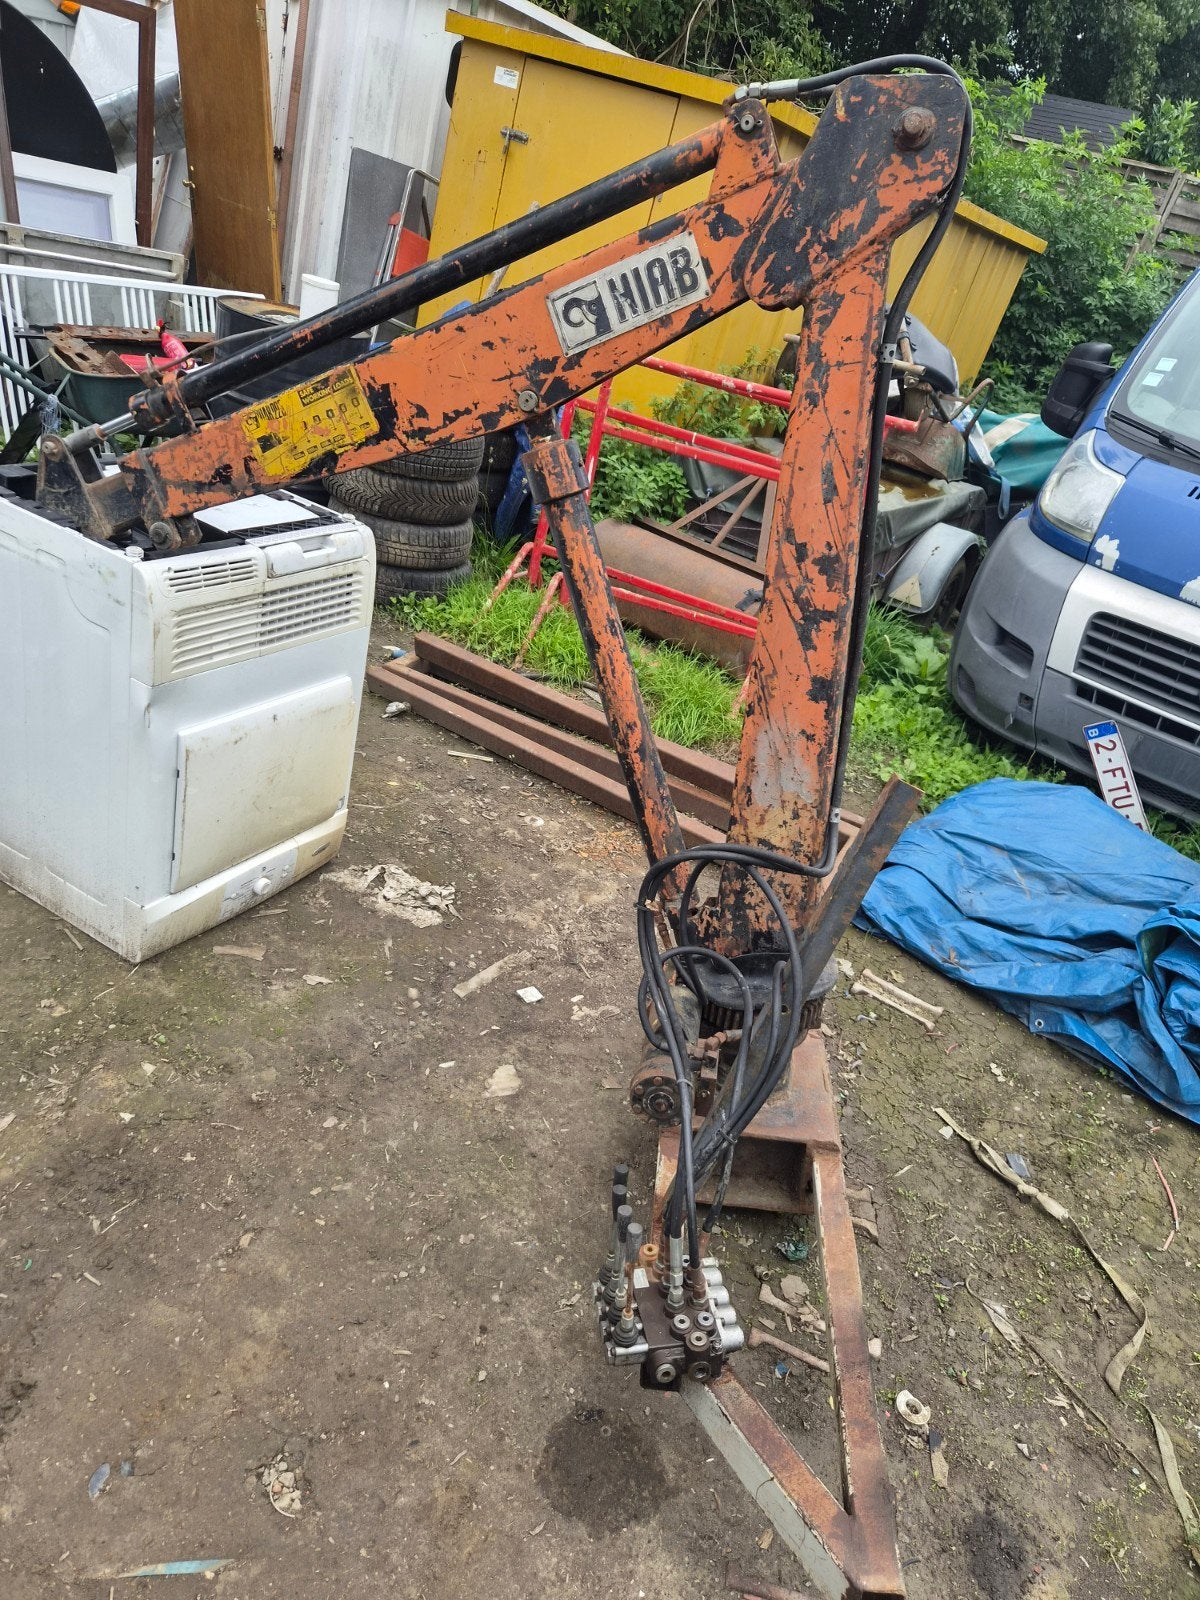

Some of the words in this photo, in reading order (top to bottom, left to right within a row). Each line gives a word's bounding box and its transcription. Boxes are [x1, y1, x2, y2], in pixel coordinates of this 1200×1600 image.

[606, 246, 699, 323] HIAB
[299, 386, 314, 398] SAFE
[302, 387, 331, 405] WORKING
[332, 377, 354, 391] LOADS
[1088, 728, 1099, 738] B
